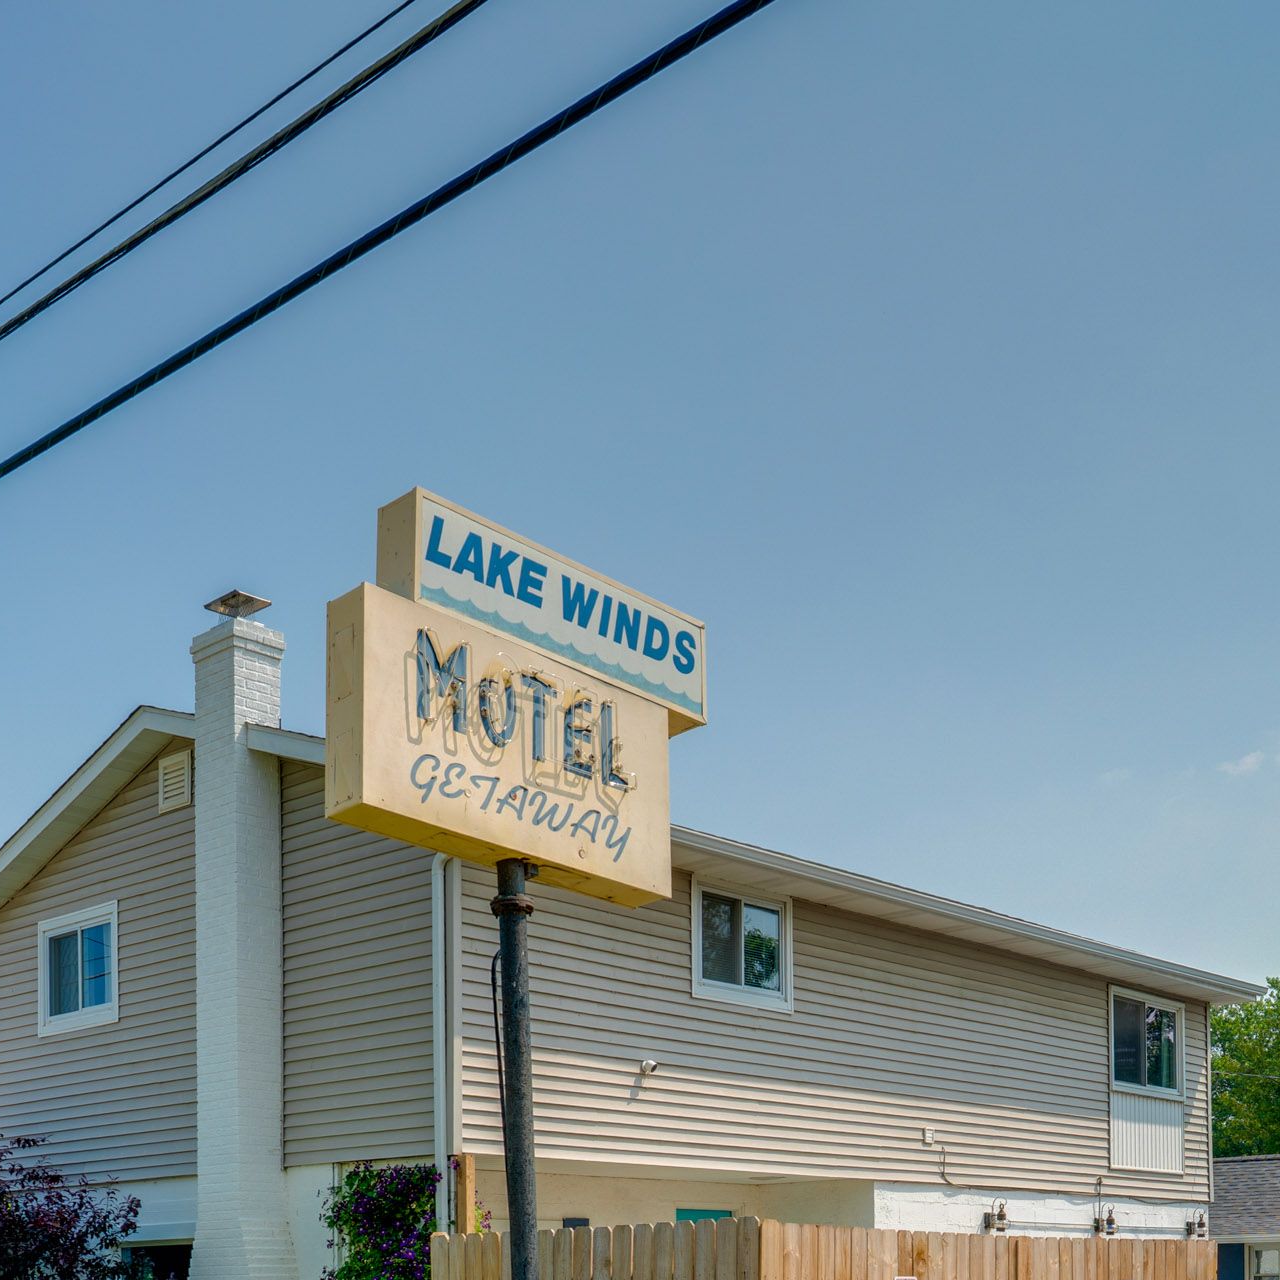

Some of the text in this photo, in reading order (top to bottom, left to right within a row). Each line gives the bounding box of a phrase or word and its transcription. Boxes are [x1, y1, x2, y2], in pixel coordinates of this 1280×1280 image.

[425, 515, 697, 675] LAKE WINDS
[416, 626, 637, 791] MOTEL
[409, 753, 632, 863] GETAWAY
